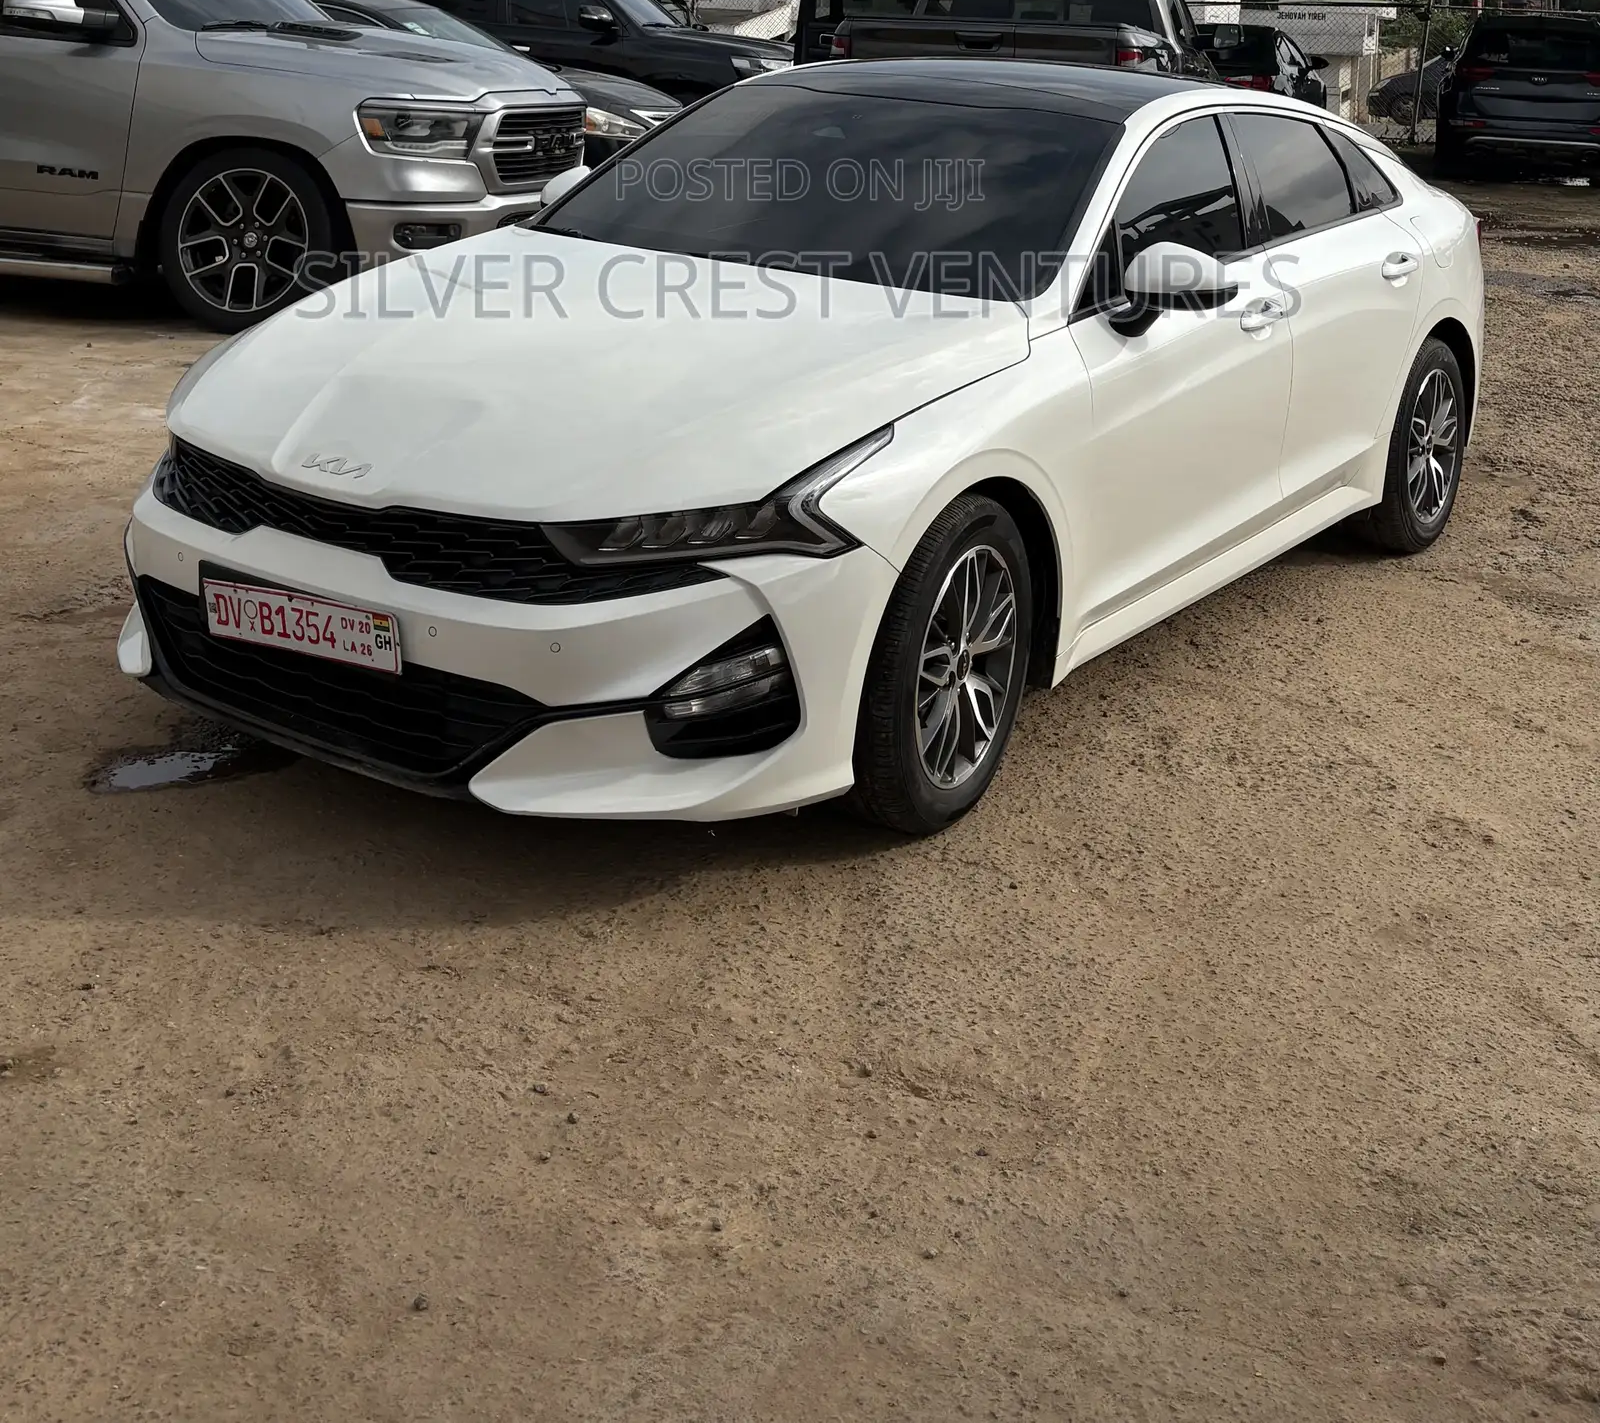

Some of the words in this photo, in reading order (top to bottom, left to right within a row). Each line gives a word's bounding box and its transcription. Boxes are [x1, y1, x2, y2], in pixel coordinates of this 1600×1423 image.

[36, 164, 99, 180] RAM
[214, 593, 242, 629] DV
[375, 633, 393, 652] GH
